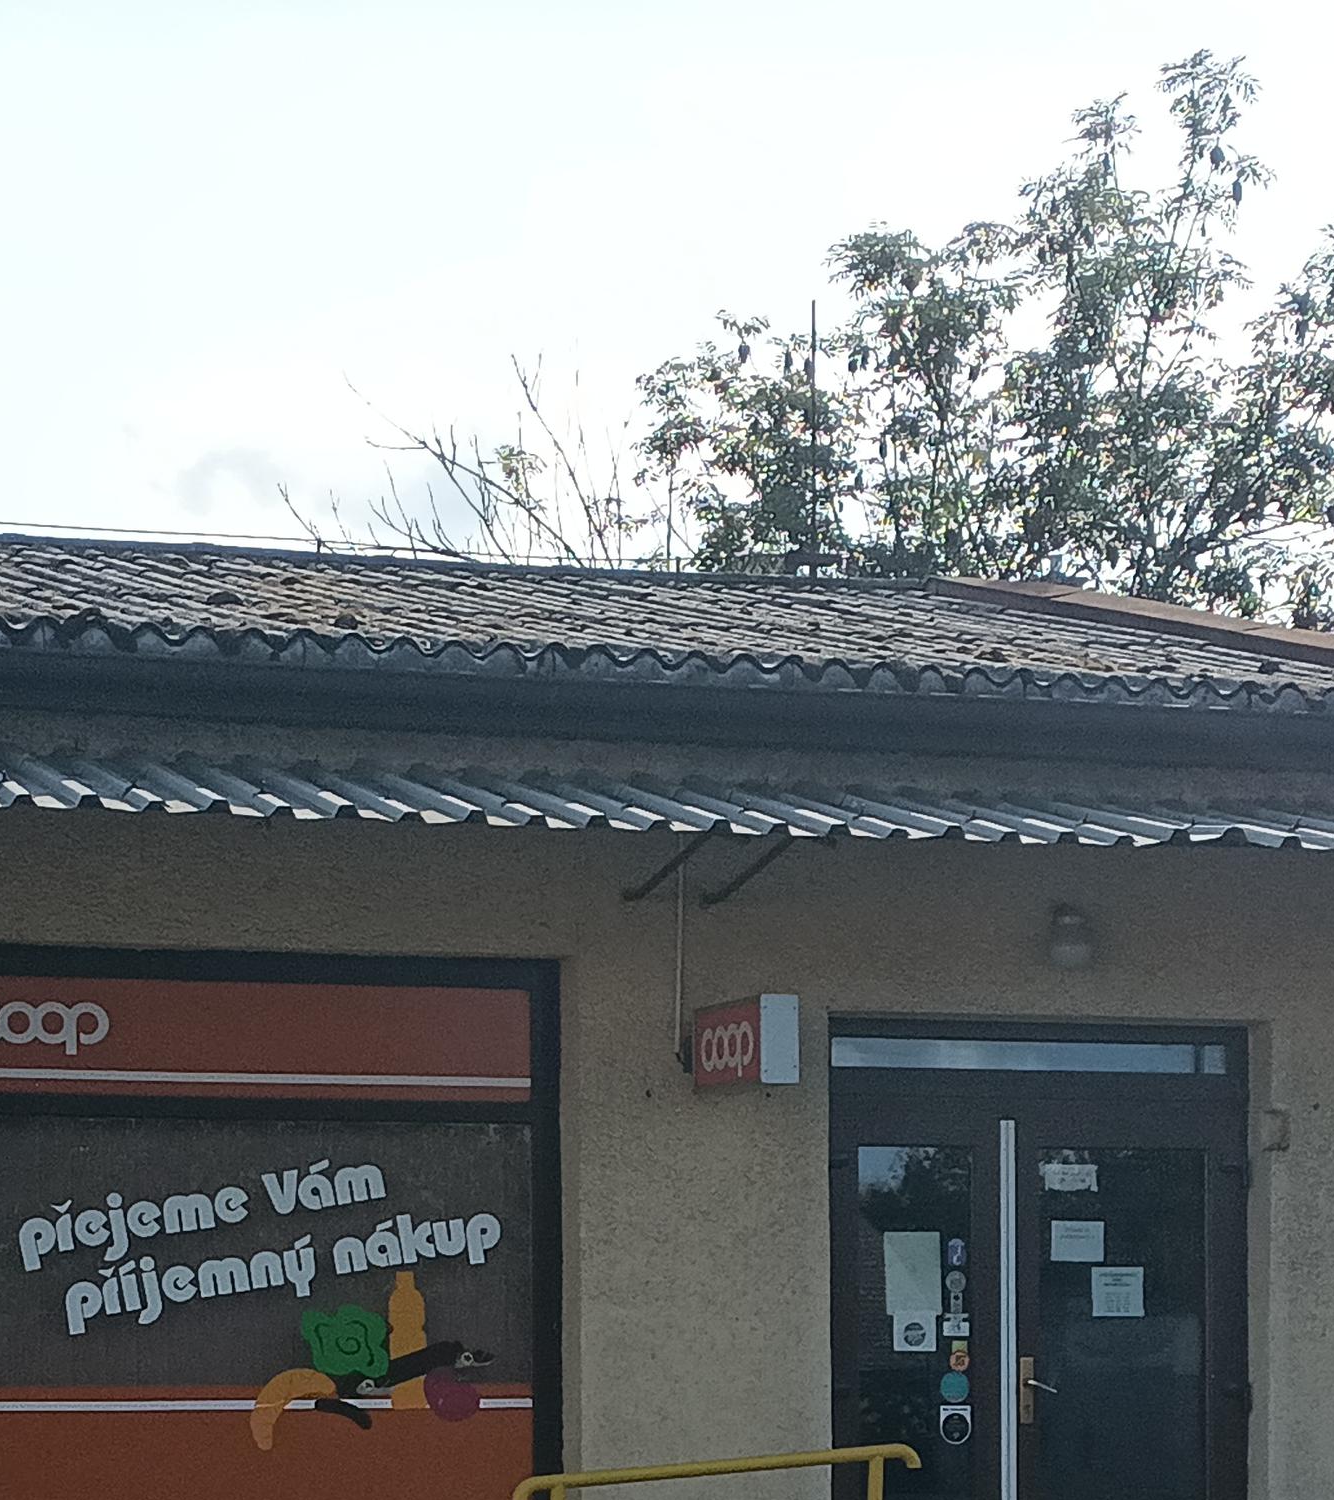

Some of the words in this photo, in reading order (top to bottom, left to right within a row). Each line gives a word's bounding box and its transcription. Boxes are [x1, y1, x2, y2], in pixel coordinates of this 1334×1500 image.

[701, 1021, 755, 1077] coop
[18, 1185, 249, 1272] přejeme
[261, 1159, 387, 1215] Vám
[64, 1234, 317, 1335] příjemný
[333, 1212, 502, 1275] nákup
